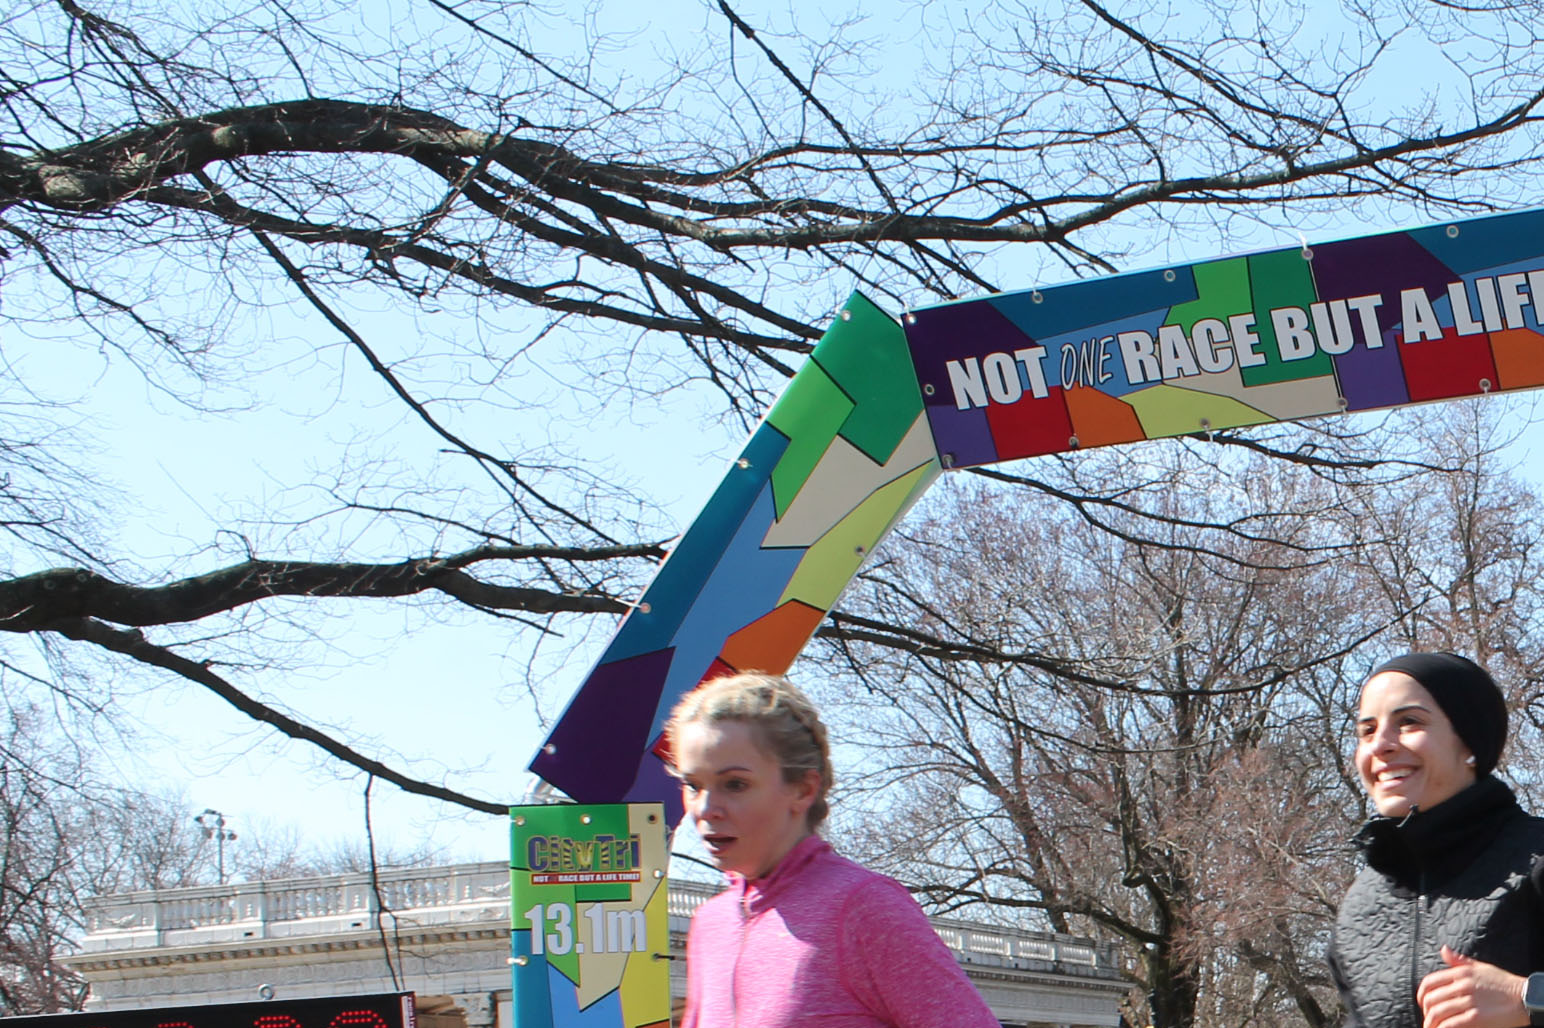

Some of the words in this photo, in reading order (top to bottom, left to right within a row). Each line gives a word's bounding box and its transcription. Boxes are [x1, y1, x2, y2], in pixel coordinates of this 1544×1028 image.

[945, 344, 1050, 412] NOT
[1059, 336, 1114, 388] ONE
[1122, 312, 1265, 386] RACE
[1270, 294, 1387, 365] BUT
[1400, 288, 1443, 343] A
[527, 833, 641, 872] CityTri
[524, 902, 647, 955] 13.1m
